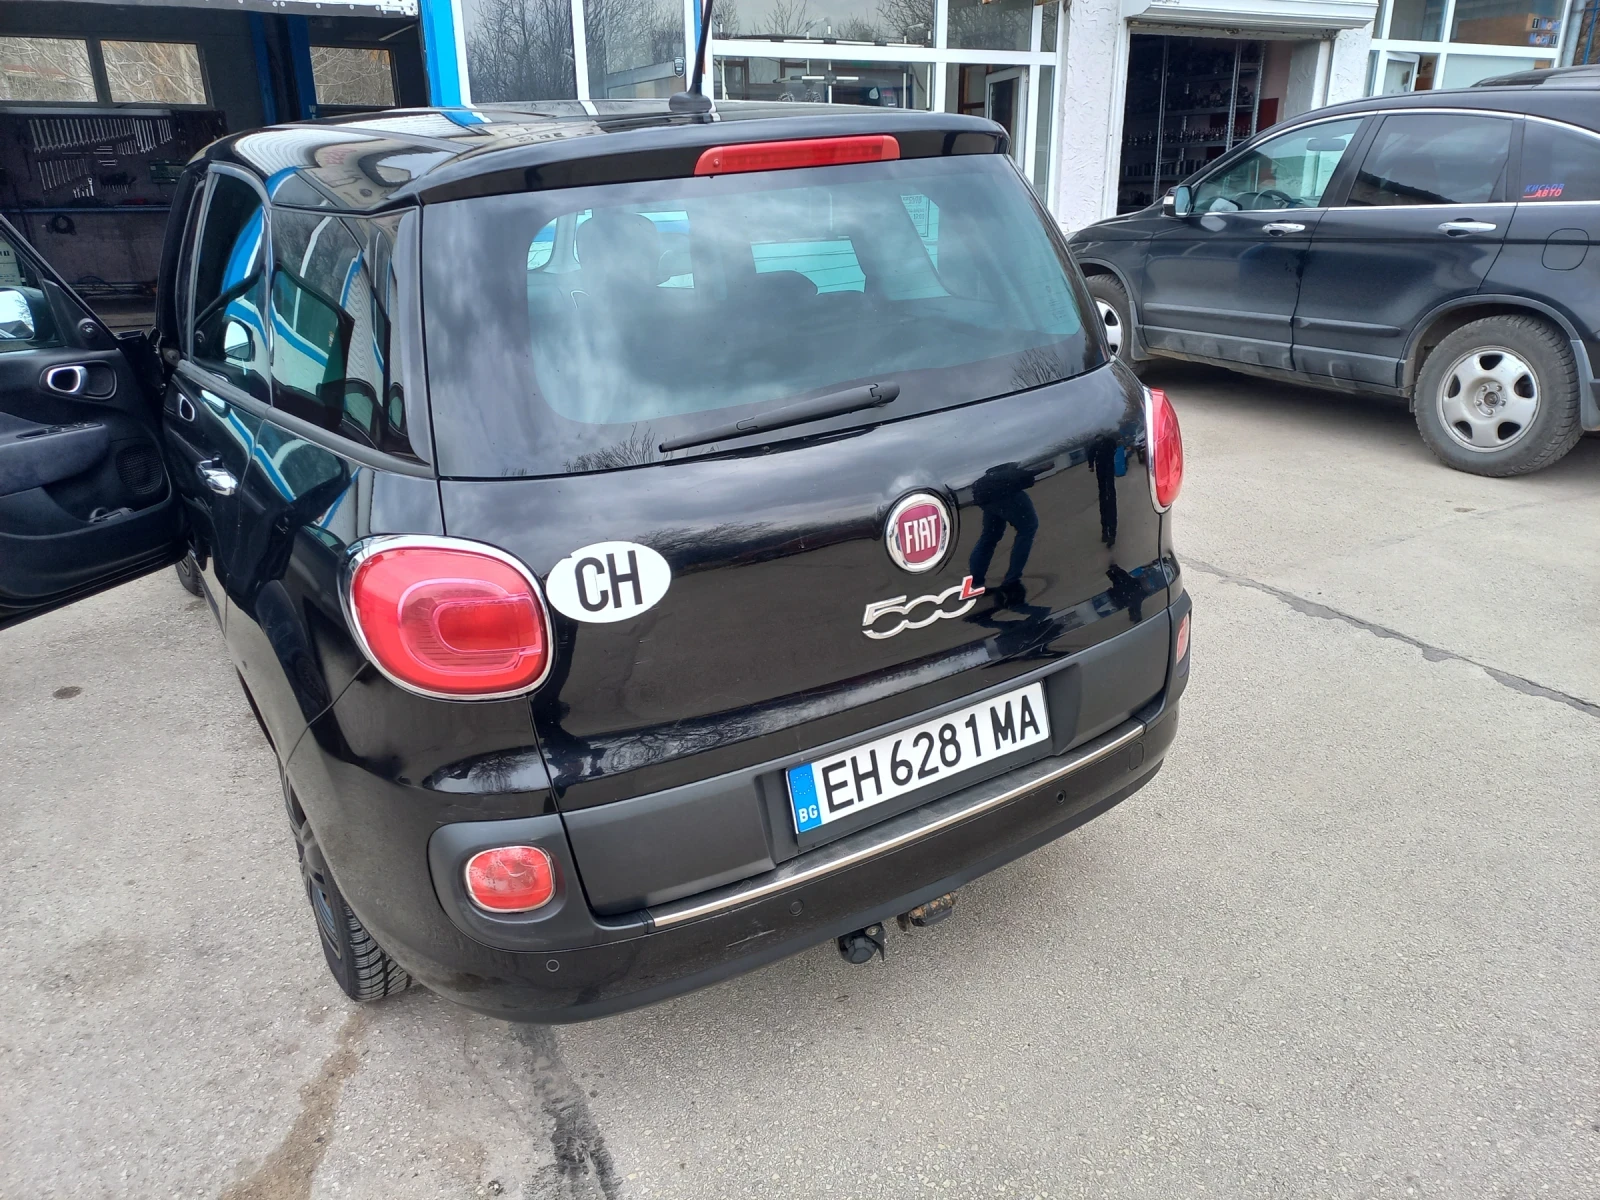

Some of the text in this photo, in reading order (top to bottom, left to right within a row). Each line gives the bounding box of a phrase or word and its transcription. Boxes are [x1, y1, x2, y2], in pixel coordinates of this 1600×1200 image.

[903, 514, 938, 554] FIAT
[574, 550, 643, 612] CH
[862, 575, 985, 640] 500L
[821, 694, 1041, 815] EH 6281 MA
[798, 804, 819, 824] BG
